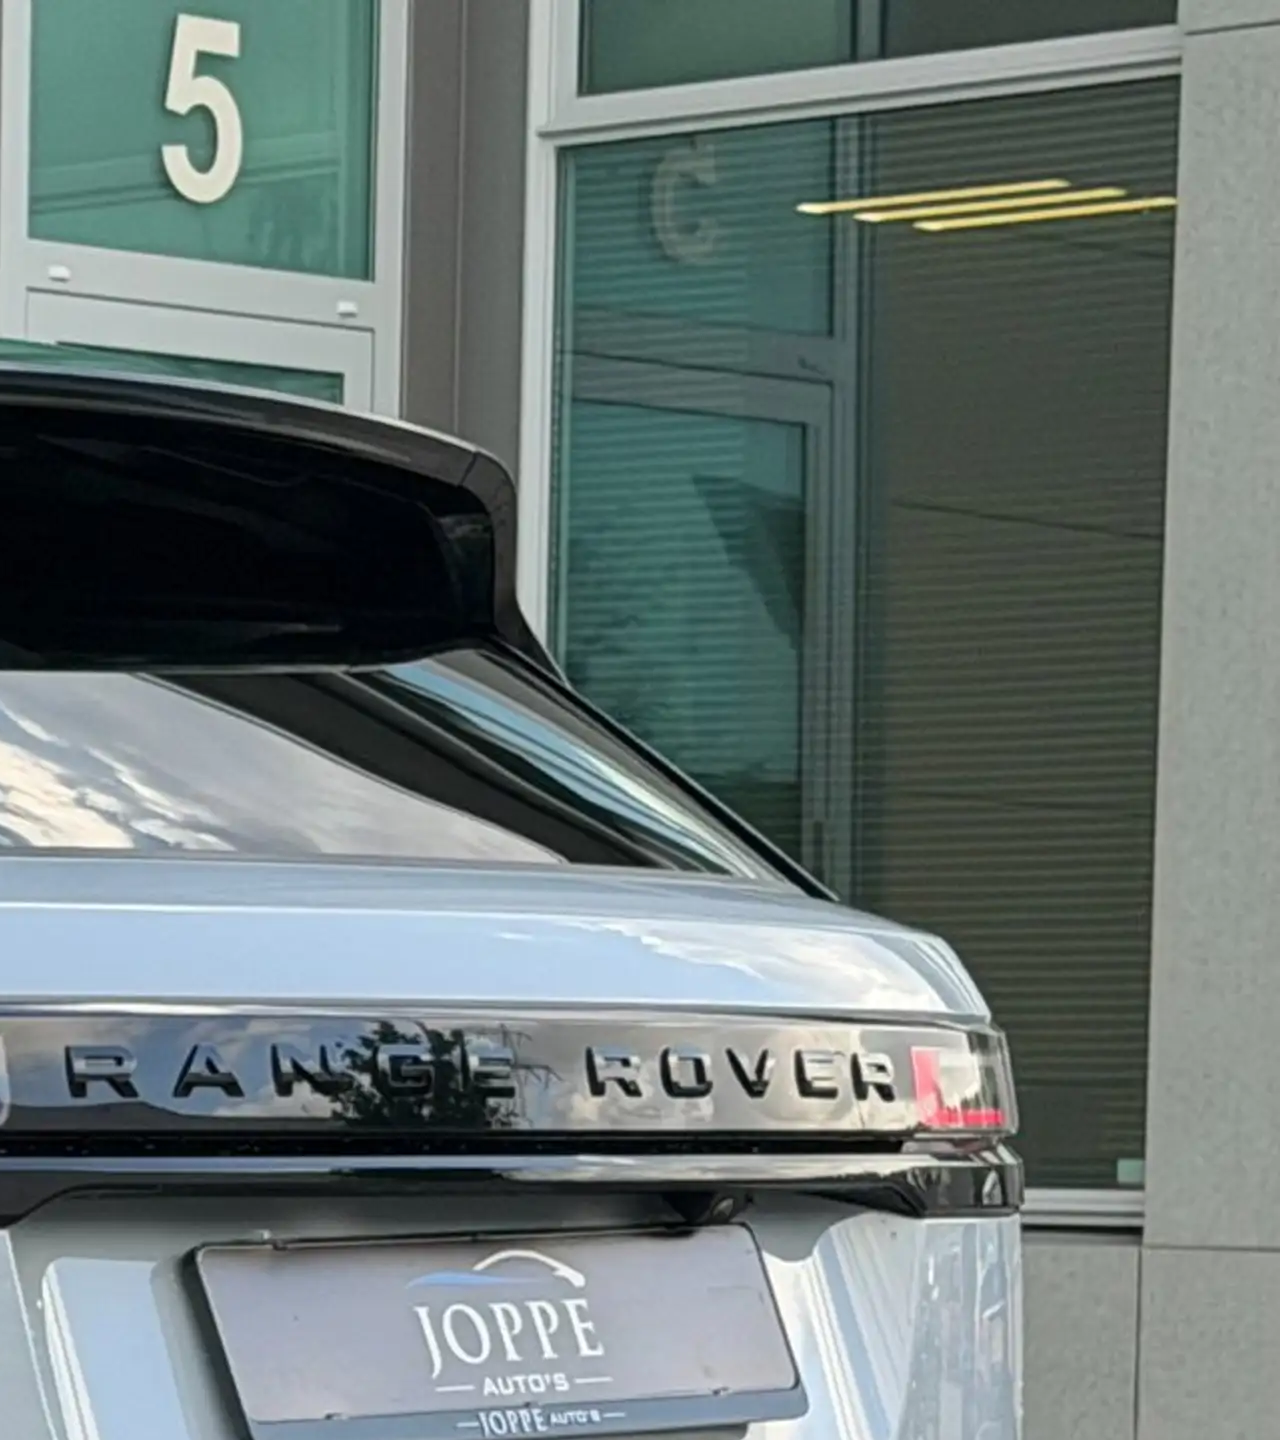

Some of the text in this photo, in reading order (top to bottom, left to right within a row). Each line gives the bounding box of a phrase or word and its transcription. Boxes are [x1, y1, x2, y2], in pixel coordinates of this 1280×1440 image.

[160, 13, 243, 204] 5
[64, 1041, 896, 1102] RANGE ROVER
[412, 1298, 605, 1379] JOPPE
[482, 1373, 570, 1397] AUTO'S
[478, 1407, 548, 1438] JOPPE
